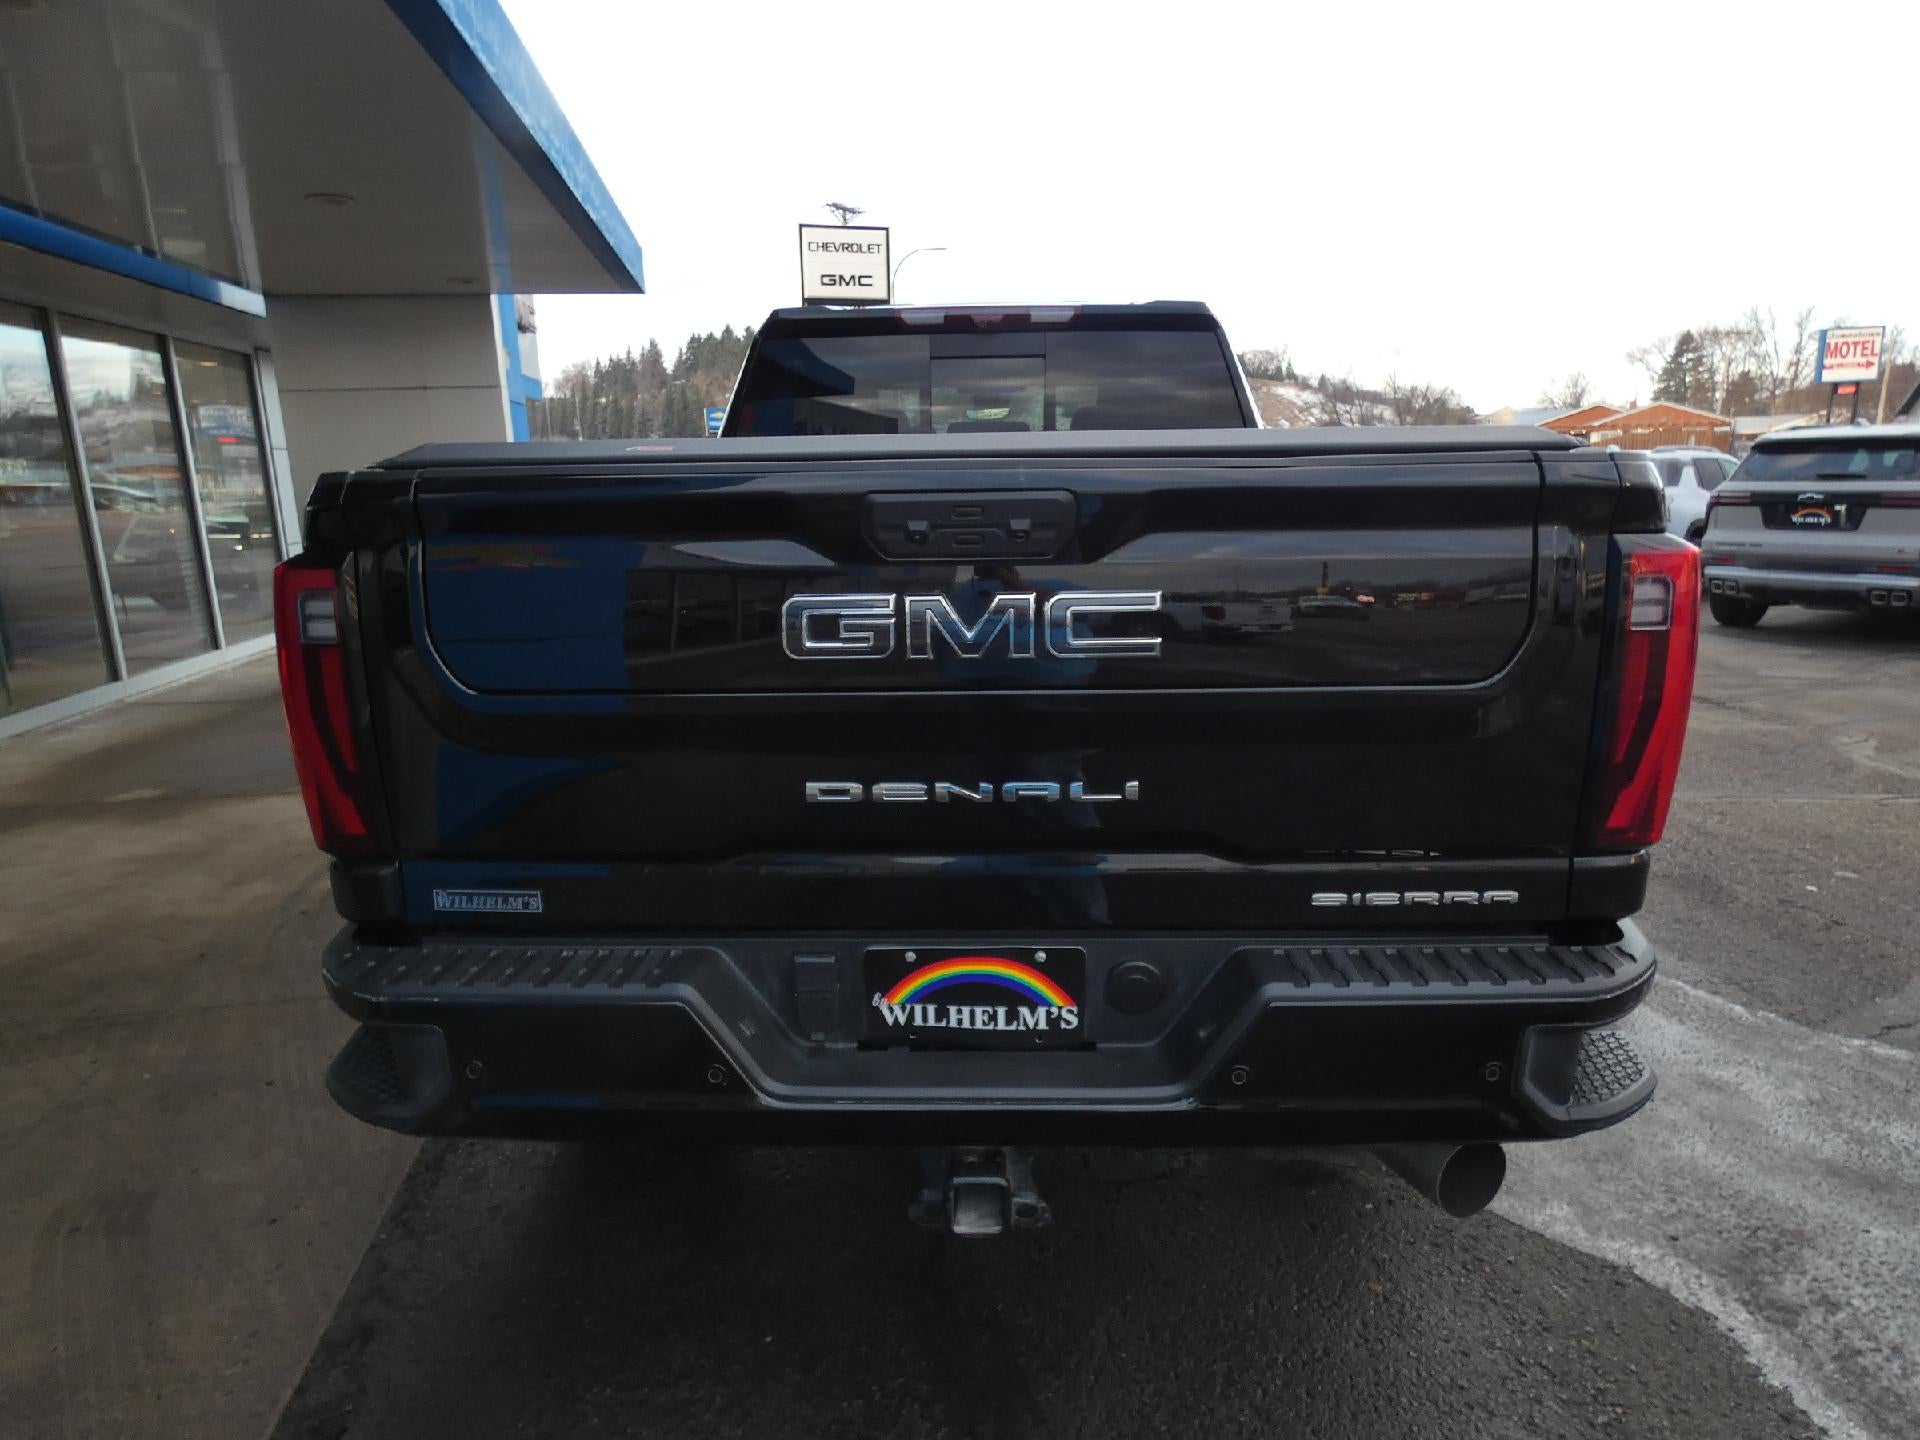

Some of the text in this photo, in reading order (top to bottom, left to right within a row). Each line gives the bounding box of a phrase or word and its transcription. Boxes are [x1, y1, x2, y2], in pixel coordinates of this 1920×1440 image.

[808, 241, 882, 254] CHEVROLET
[820, 274, 873, 287] GMC
[1825, 340, 1878, 359] MOTEL
[782, 590, 1162, 659] GMC
[805, 781, 1139, 802] DENALI
[437, 891, 538, 910] WILHELM'S
[1311, 890, 1519, 905] SIERRA
[880, 1004, 1079, 1030] WILHELM'S
